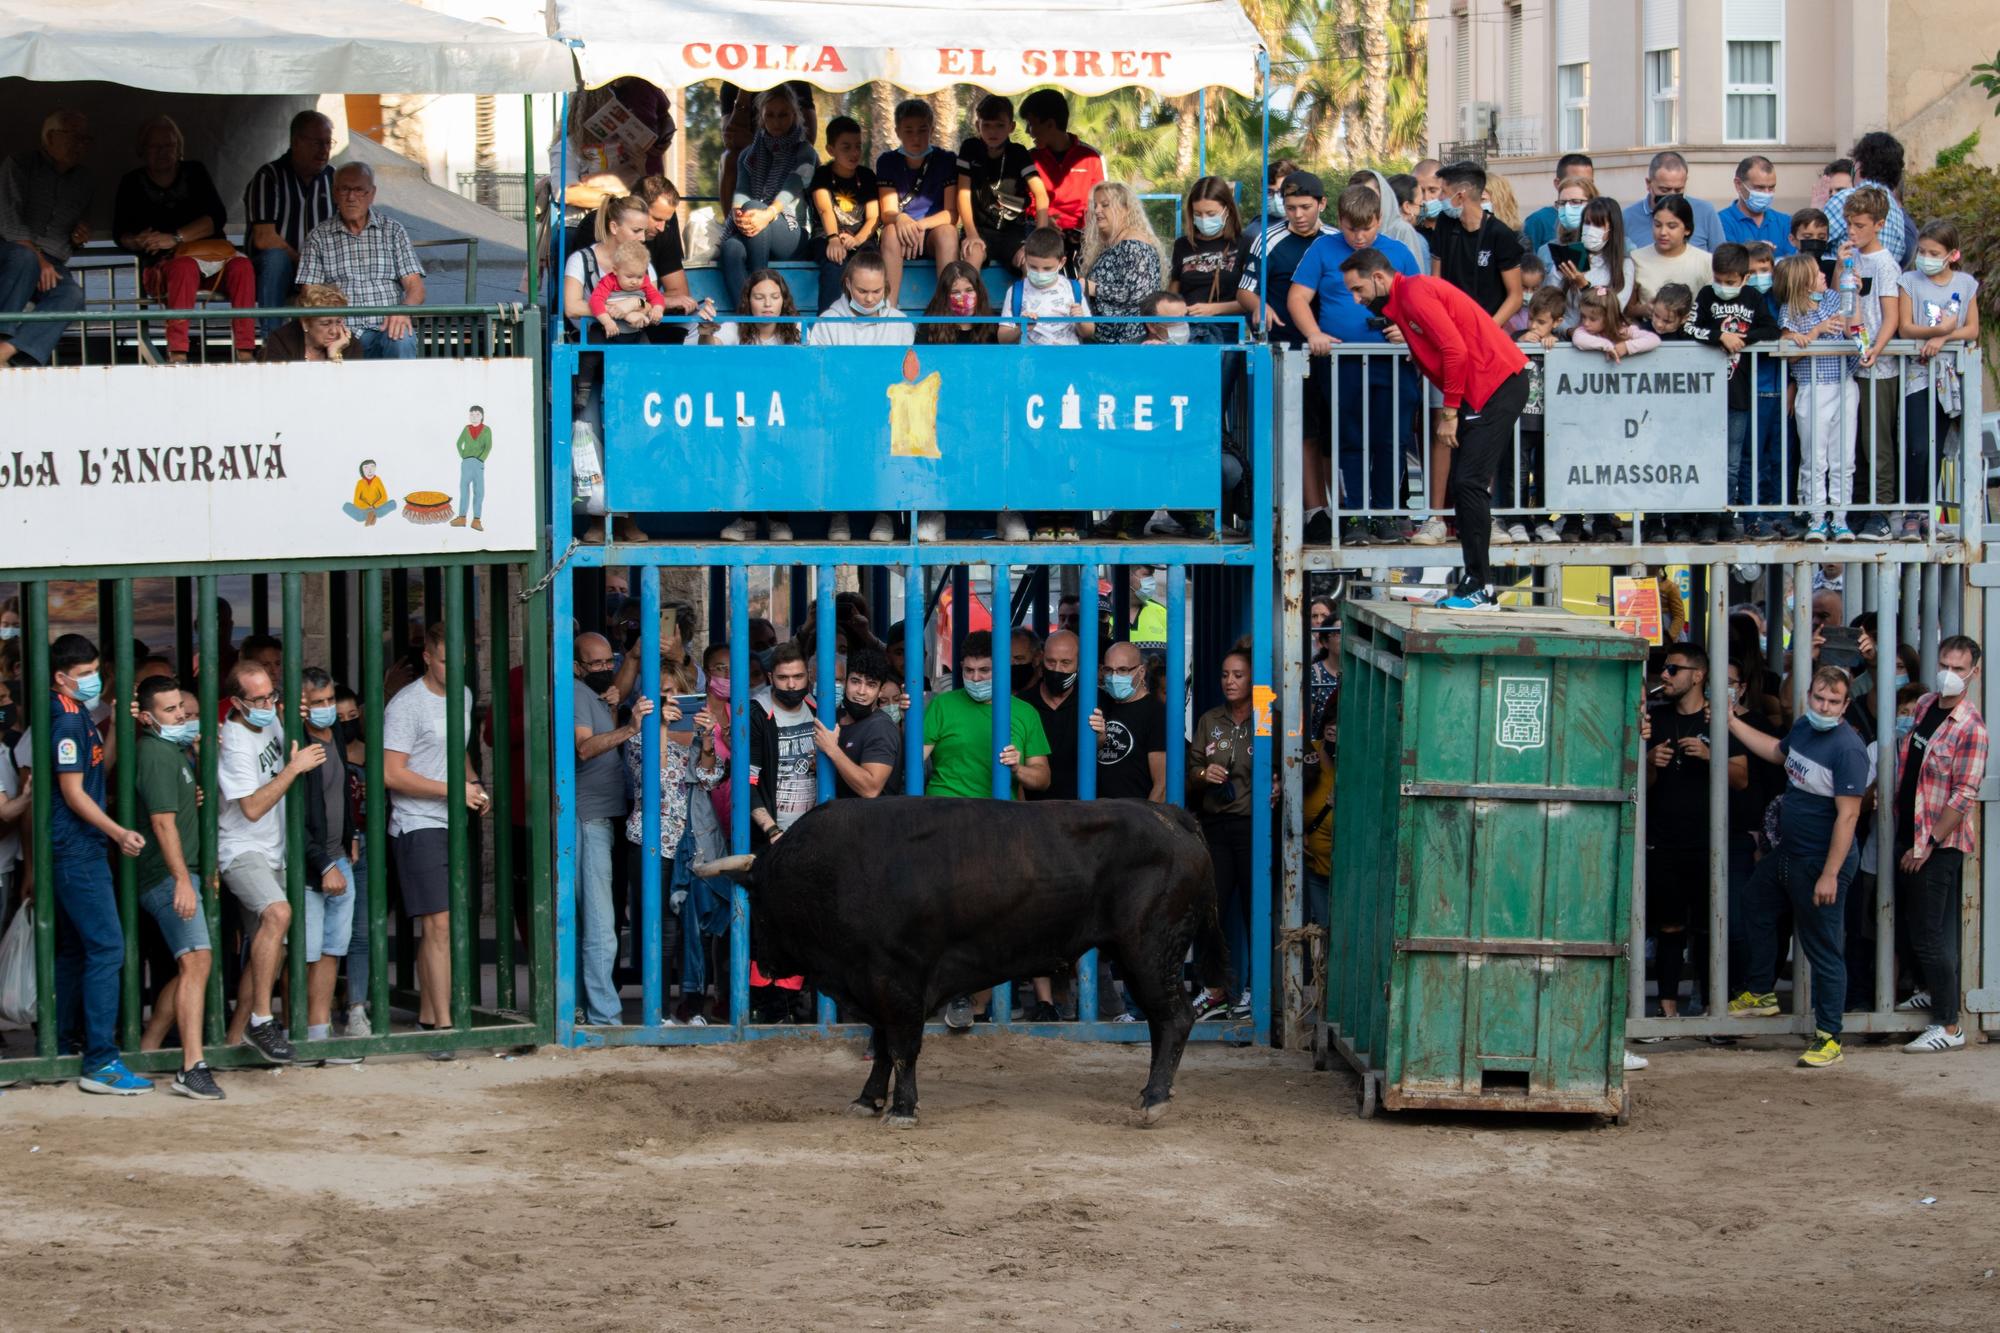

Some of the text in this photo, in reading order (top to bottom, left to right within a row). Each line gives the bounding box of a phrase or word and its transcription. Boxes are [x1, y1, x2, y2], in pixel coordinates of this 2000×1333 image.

[682, 42, 848, 72] COLLA
[936, 48, 1172, 77] EL SIRET
[1557, 372, 1715, 395] AJUNTAMENT
[643, 391, 786, 427] COLLA
[1624, 409, 1649, 438] D'
[79, 432, 287, 486] L'ANGRAVÁ
[1567, 464, 1700, 486] ALMASSORA
